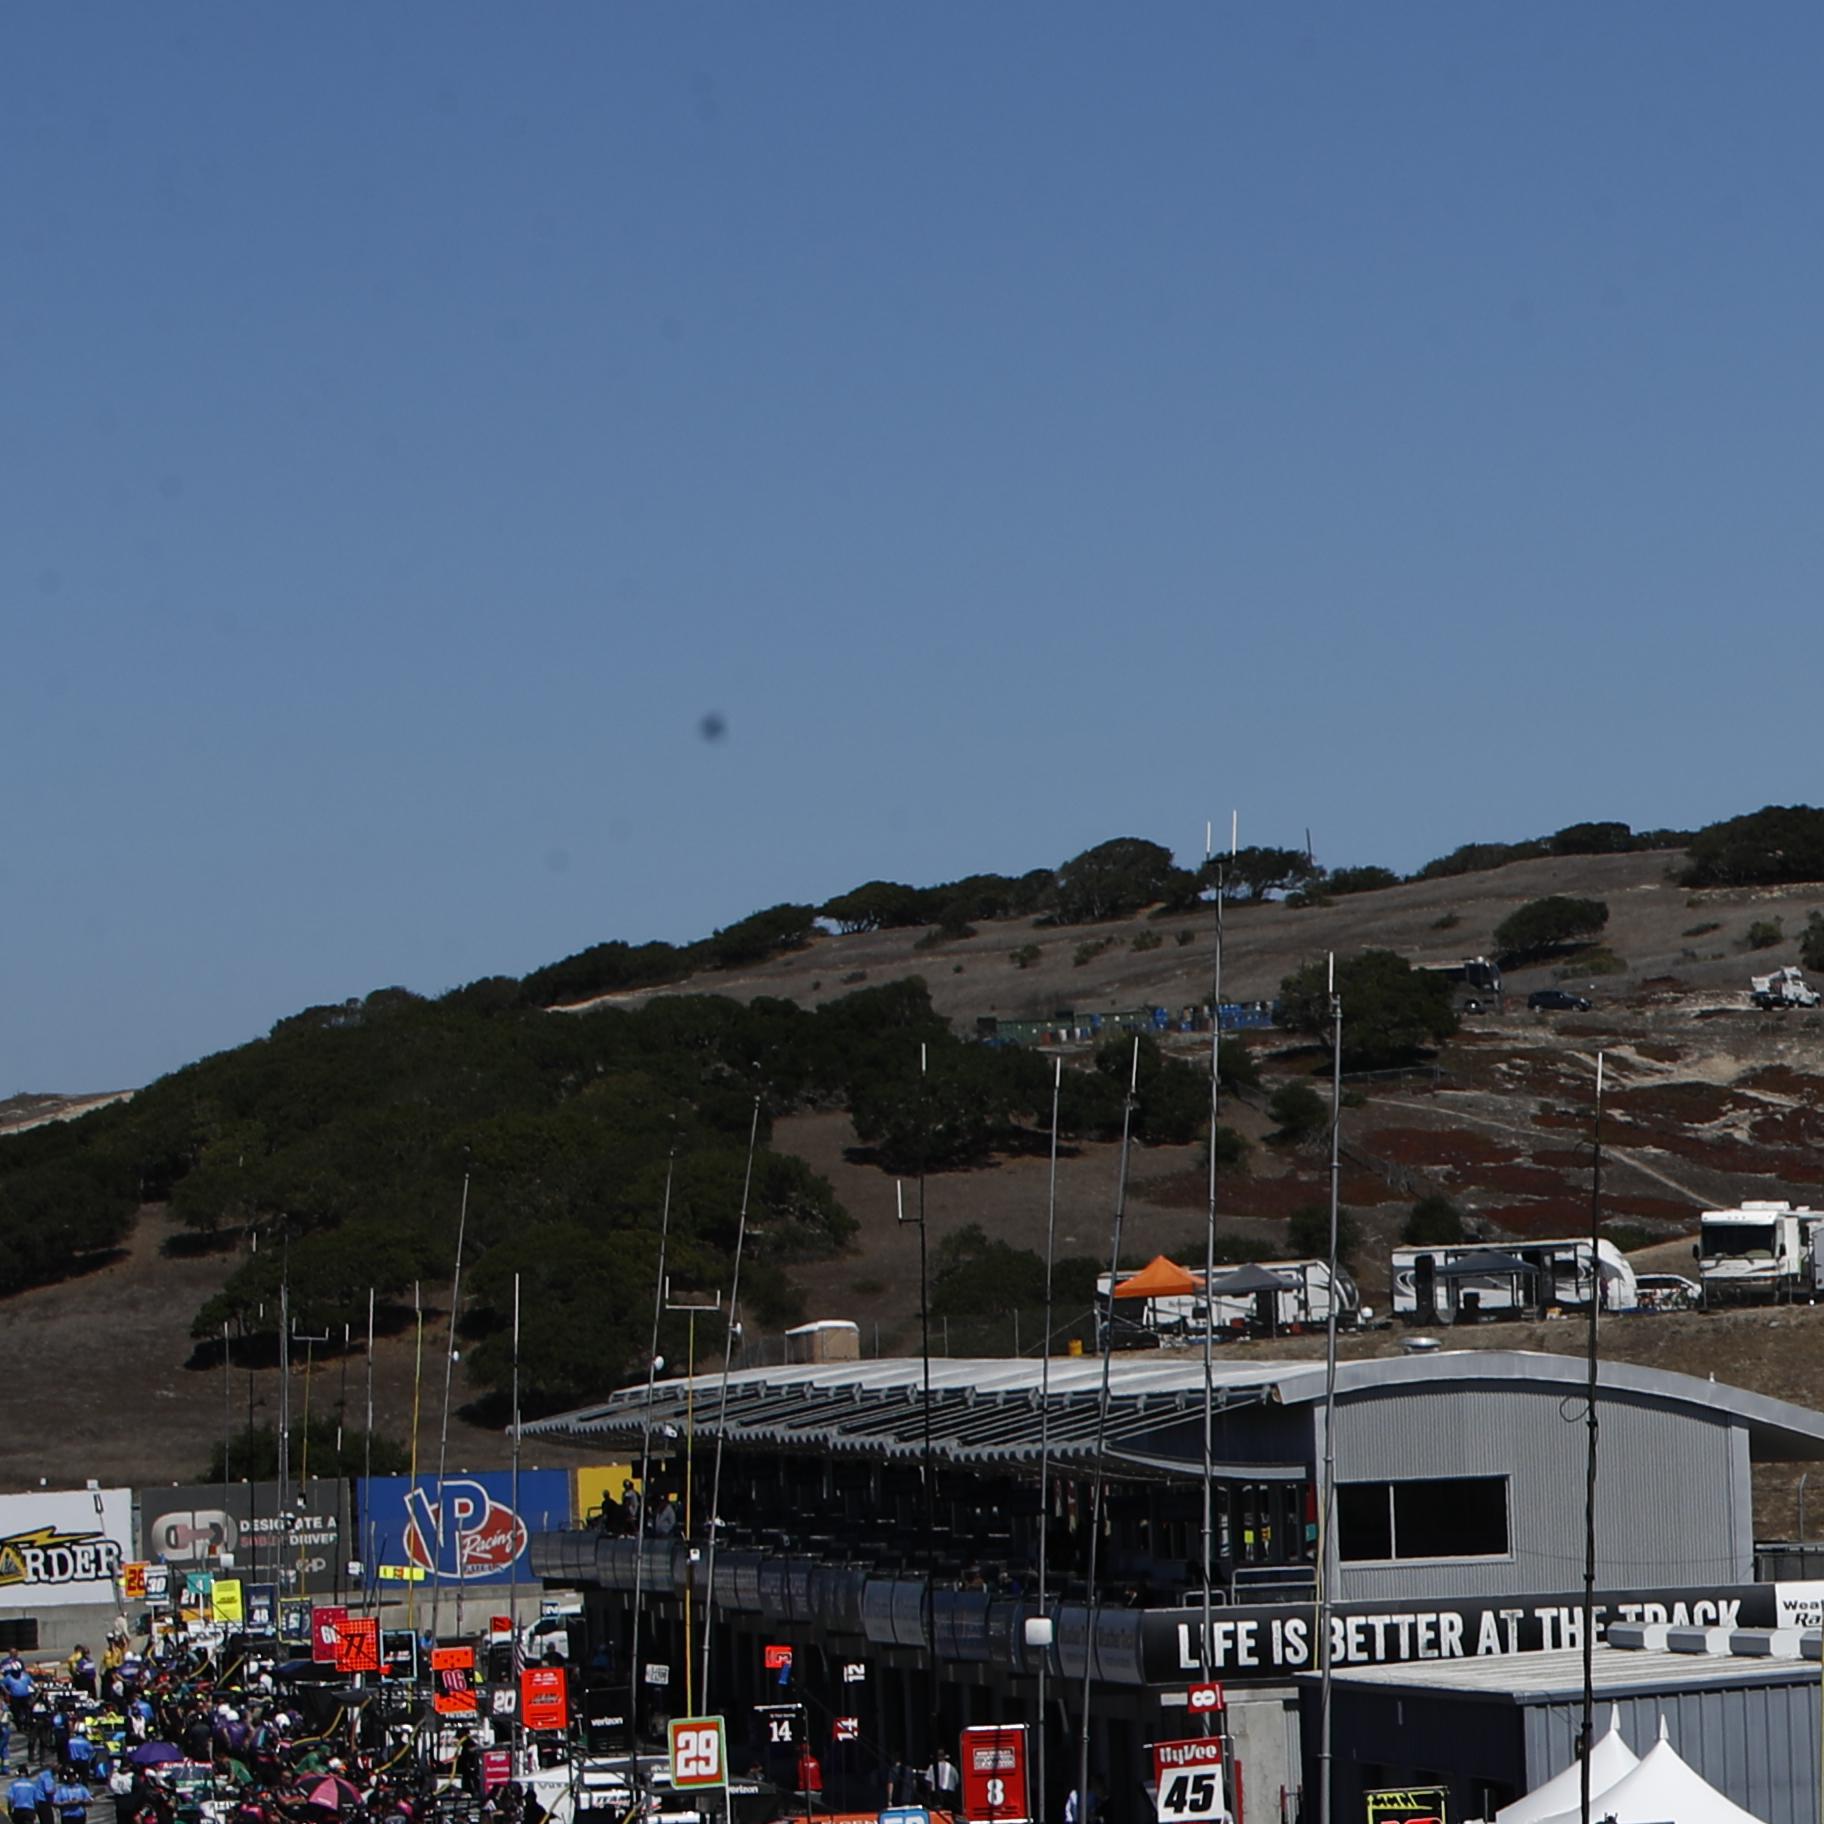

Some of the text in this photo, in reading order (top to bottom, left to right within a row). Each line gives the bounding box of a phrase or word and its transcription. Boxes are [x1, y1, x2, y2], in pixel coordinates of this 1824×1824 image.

[1272, 1617, 1309, 1666] IS
[1330, 1612, 1464, 1664] BETTER
[1476, 1609, 1524, 1656] AT
[1534, 1605, 1607, 1652] THE
[494, 1689, 516, 1714] 20
[591, 1716, 623, 1727] verizon
[769, 1721, 792, 1742] 14
[676, 1730, 719, 1776] 29
[985, 1778, 1005, 1806] 8
[1164, 1773, 1216, 1815] 45
